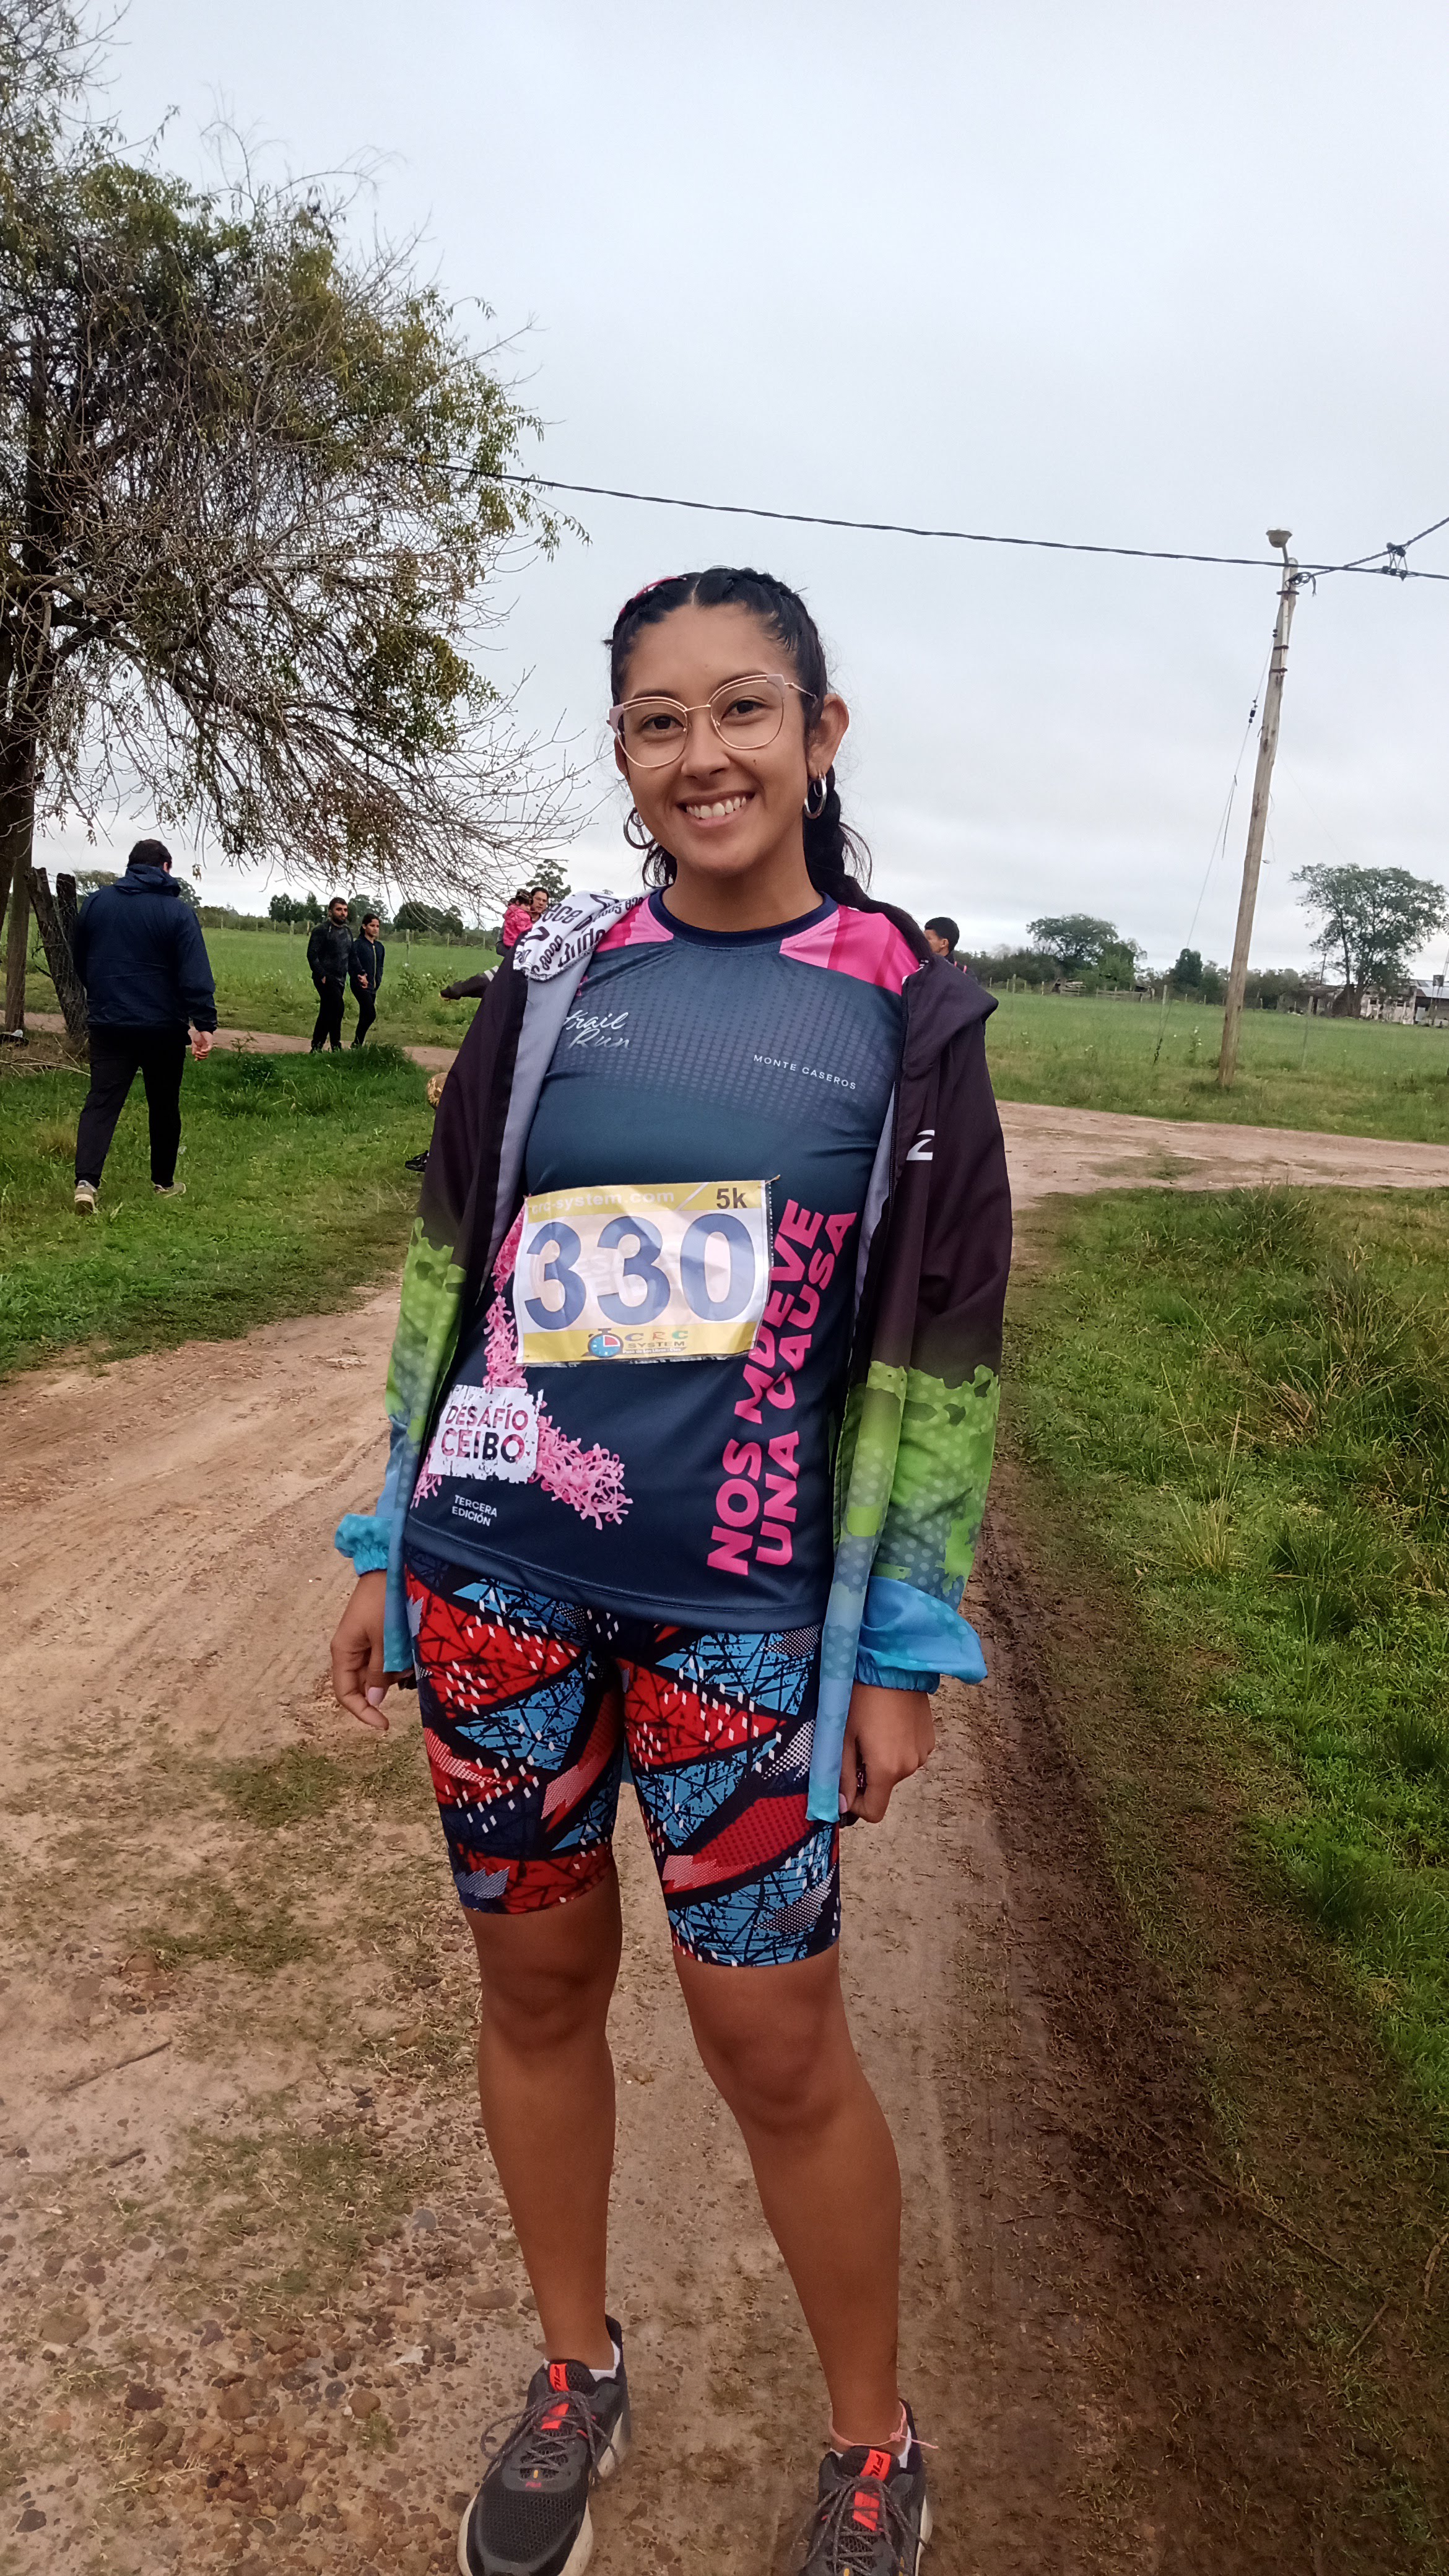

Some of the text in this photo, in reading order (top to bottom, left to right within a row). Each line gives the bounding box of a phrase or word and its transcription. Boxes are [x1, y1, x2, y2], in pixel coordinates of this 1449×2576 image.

[567, 1027, 631, 1050] Run
[753, 1054, 856, 1090] MONTE CASEROS
[524, 1212, 756, 1331] 330
[627, 1341, 685, 1349] SYSTEM
[707, 1199, 824, 1576] NOS MUEVE
[755, 1211, 857, 1566] UNA CAUSA
[445, 1403, 529, 1431] DESAFÍO
[440, 1428, 525, 1463] CEIBO
[451, 1505, 491, 1526] EDICIÓN
[454, 1494, 497, 1517] TERCERA
